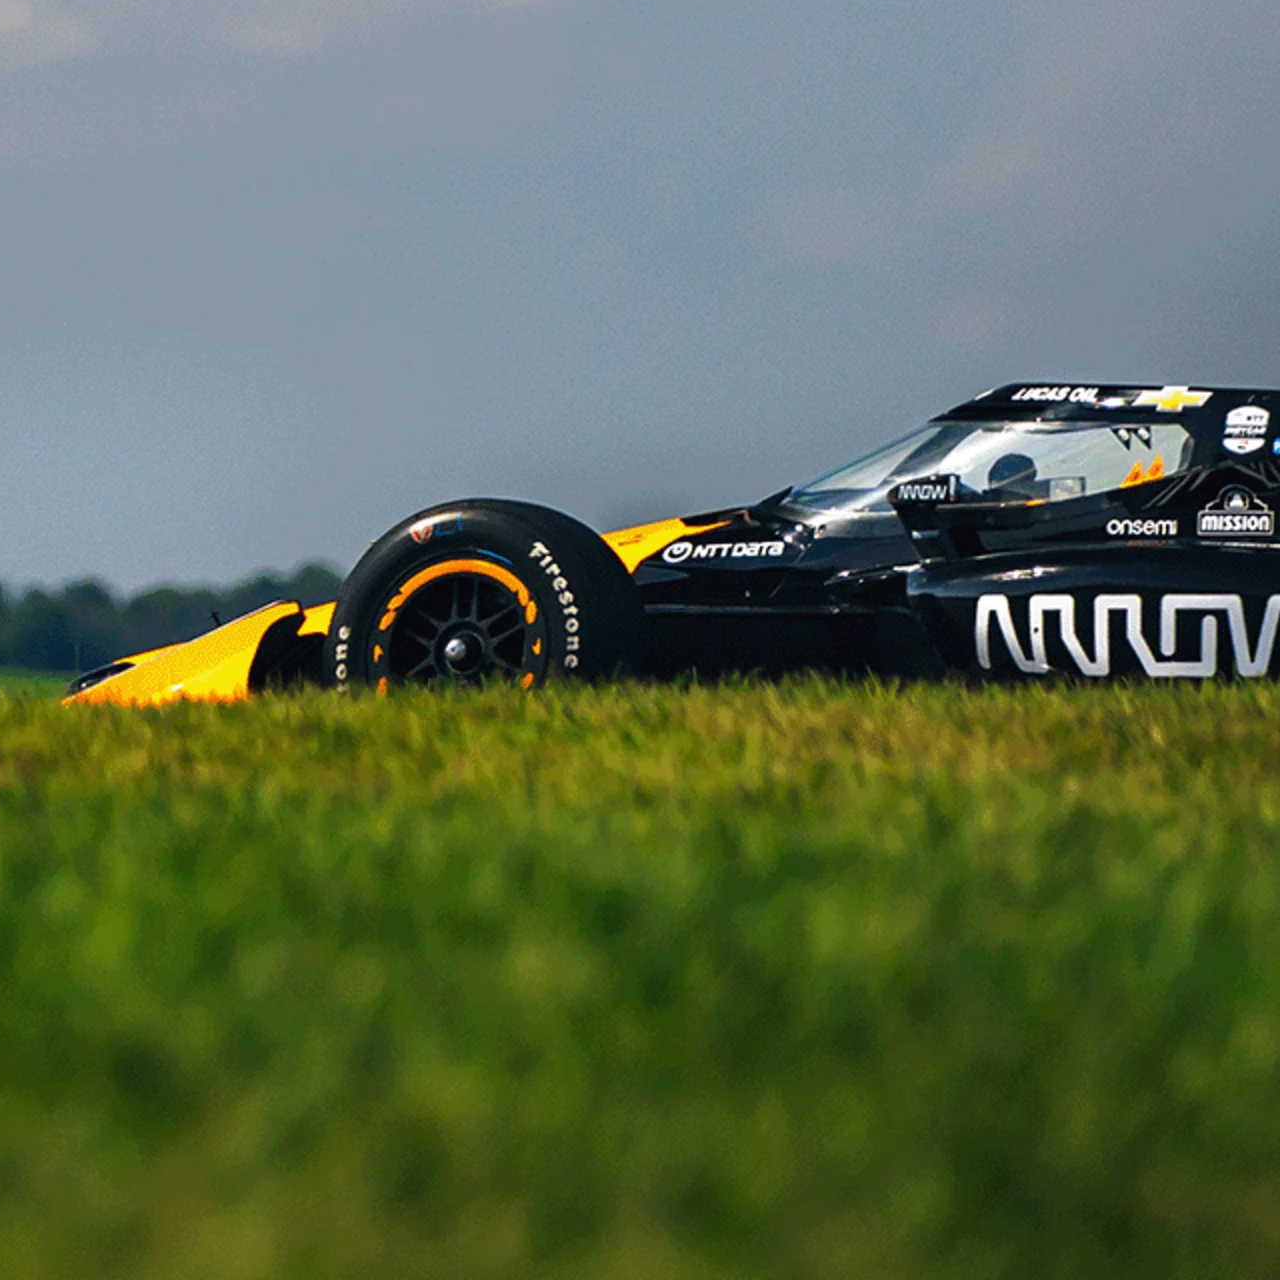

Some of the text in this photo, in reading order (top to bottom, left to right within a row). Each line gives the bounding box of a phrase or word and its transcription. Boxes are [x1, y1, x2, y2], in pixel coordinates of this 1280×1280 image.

[1011, 387, 1100, 403] LUCAS OIL
[1106, 519, 1177, 535] onsemi
[692, 544, 731, 558] NTT
[529, 541, 580, 669] Firestone
